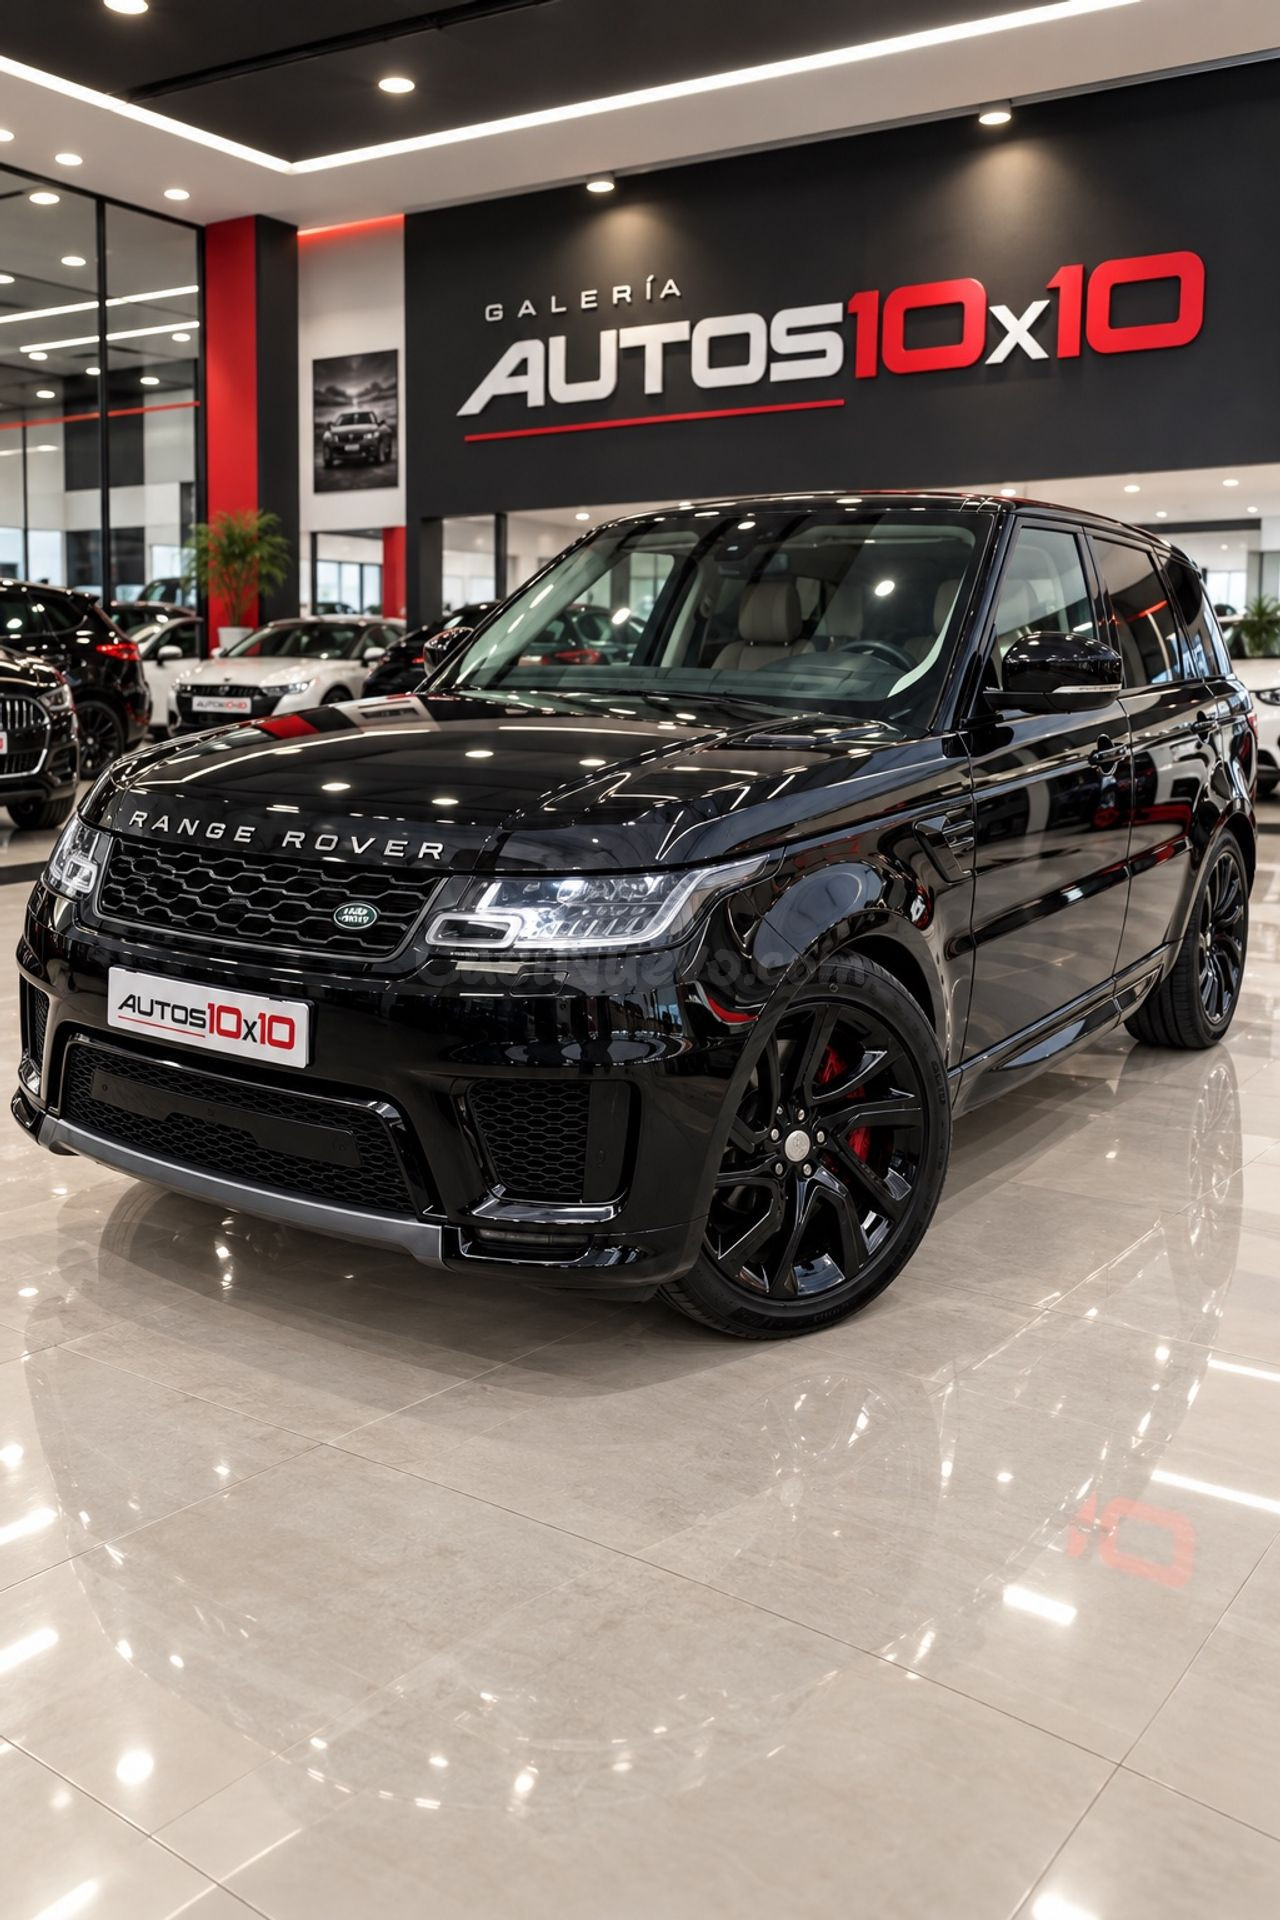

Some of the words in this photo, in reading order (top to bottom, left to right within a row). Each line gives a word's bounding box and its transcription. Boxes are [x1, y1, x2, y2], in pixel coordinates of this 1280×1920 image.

[485, 274, 682, 321] GALERÍA
[128, 810, 256, 843] RANGE
[281, 830, 446, 861] ROVER
